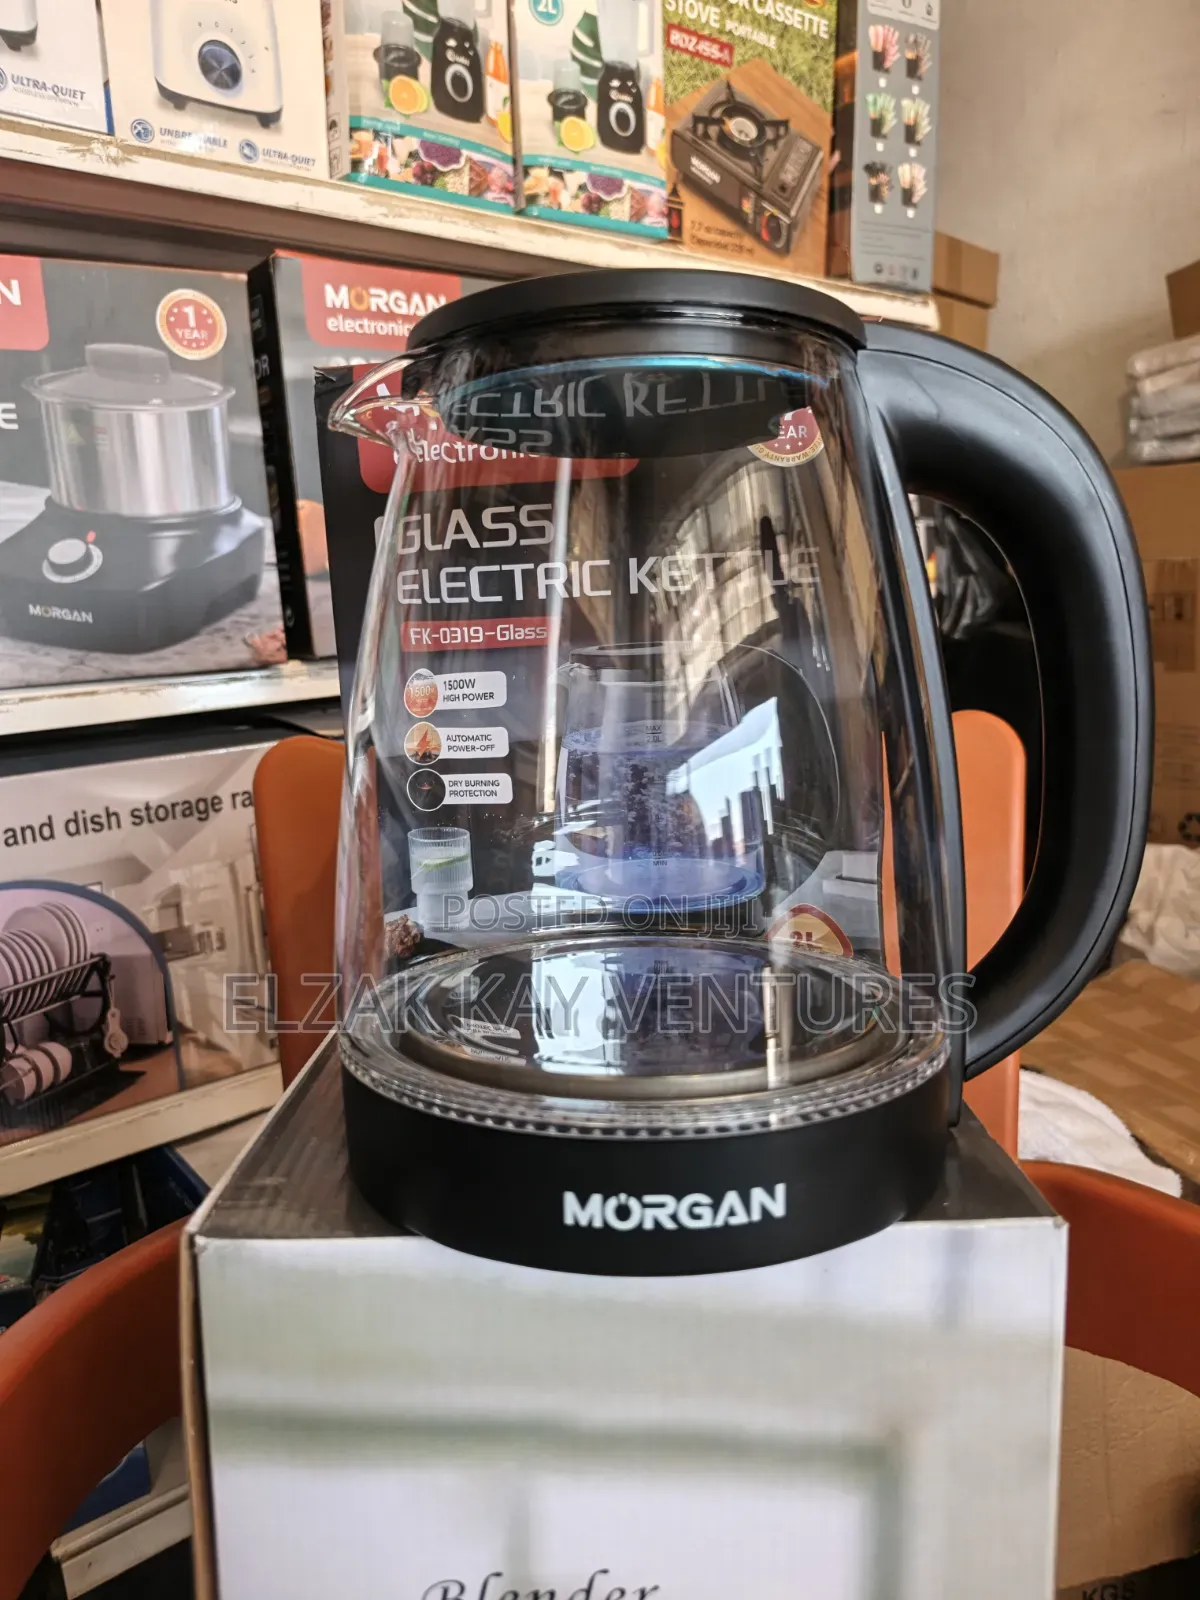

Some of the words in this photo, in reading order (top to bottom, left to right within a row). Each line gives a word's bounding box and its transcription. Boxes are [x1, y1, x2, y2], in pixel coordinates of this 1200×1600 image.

[665, 0, 721, 29] STOVE
[753, 0, 830, 40] CASSETTE
[725, 20, 778, 50] PORTABLE
[11, 73, 86, 101] ULTRA-QUIET
[159, 127, 229, 149] UNBREABLE
[262, 147, 317, 168] ULTRA-QUIET
[324, 283, 447, 317] MORGAN
[182, 305, 196, 329] 1
[326, 313, 416, 337] electronic
[176, 328, 209, 340] YEAR
[778, 425, 808, 439] EAR
[396, 503, 555, 555] GLASS
[396, 559, 612, 605] ELECTRIC
[28, 603, 94, 624] MORGAN
[409, 623, 549, 646] FK-0319-Glass
[443, 679, 476, 691] 1500W
[442, 693, 460, 702] HIGH
[462, 692, 495, 702] POWER
[446, 734, 493, 742] AUTOMATIC
[447, 744, 496, 752] POWER-OFF
[448, 780, 463, 788] DRY
[464, 779, 500, 787] BURNING
[449, 789, 498, 797] PROTECTION
[3, 815, 56, 848] and
[64, 806, 122, 837] dish
[130, 795, 224, 827] storage
[231, 790, 254, 810] ra
[563, 1182, 787, 1232] MORGAN
